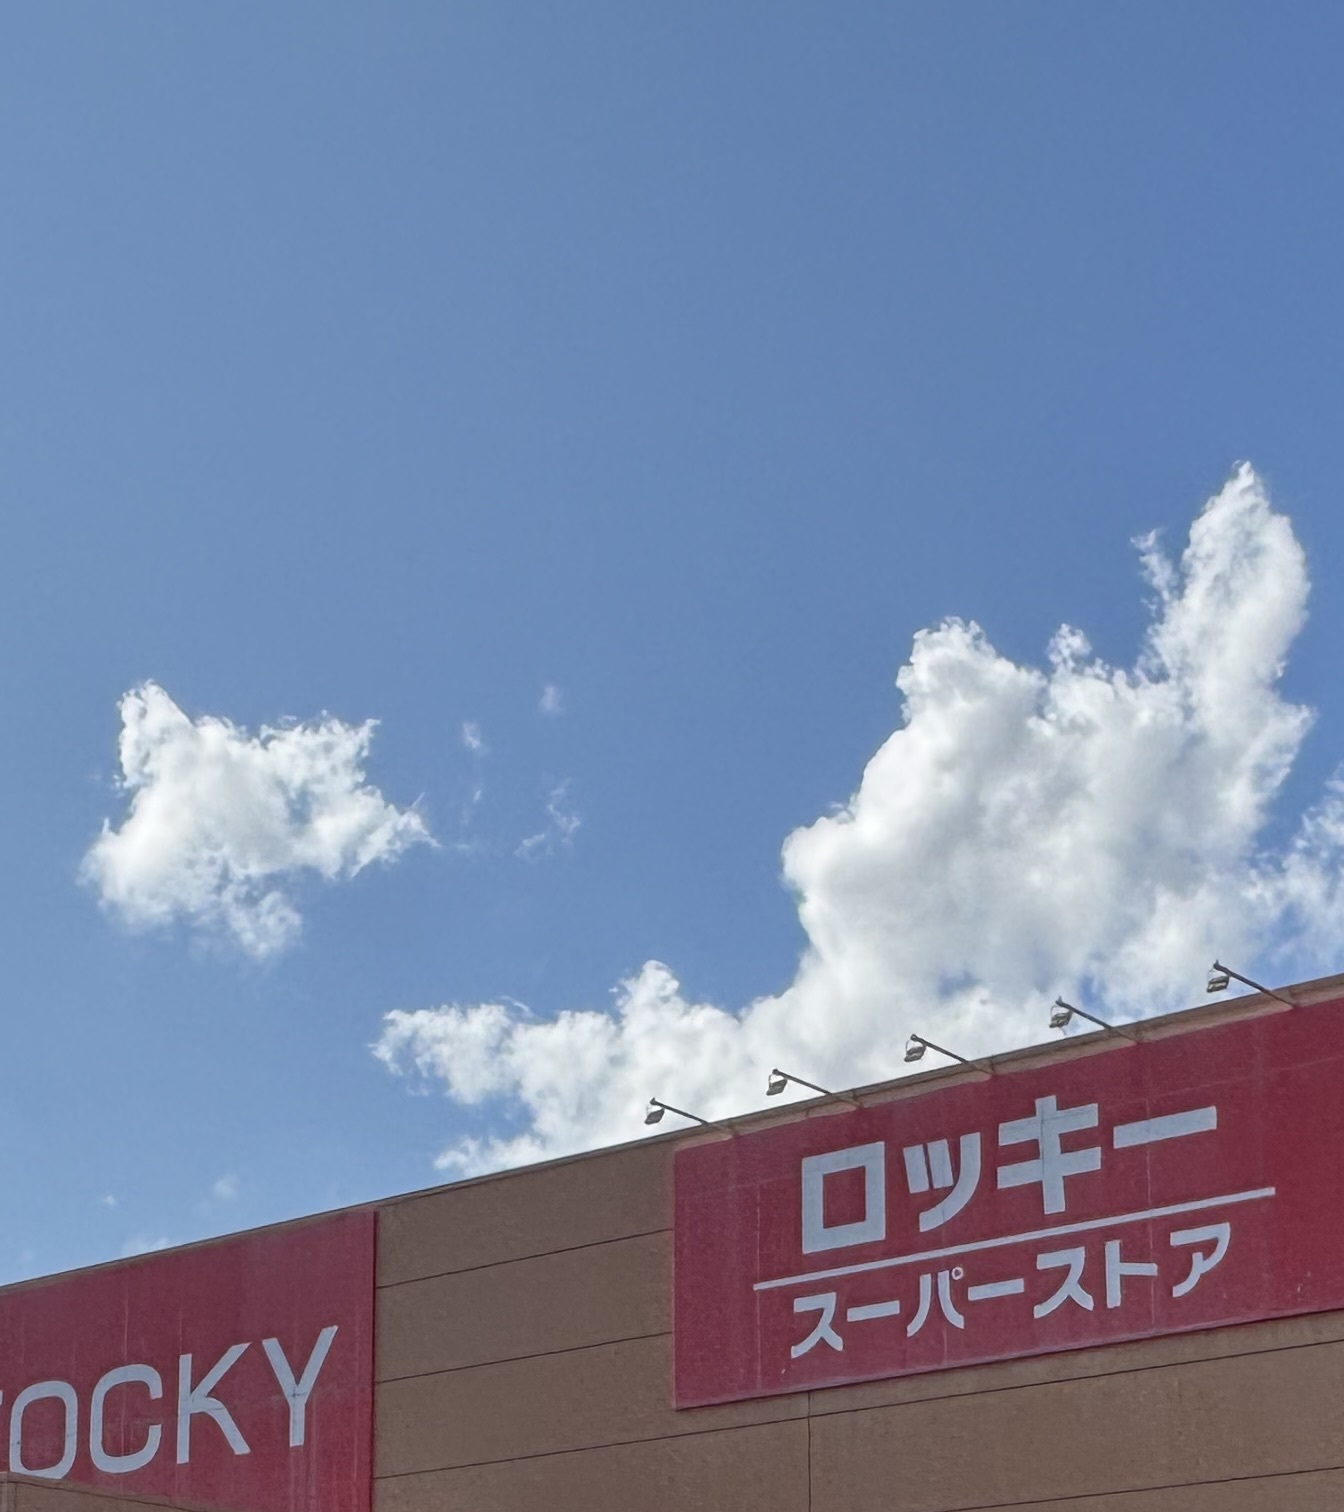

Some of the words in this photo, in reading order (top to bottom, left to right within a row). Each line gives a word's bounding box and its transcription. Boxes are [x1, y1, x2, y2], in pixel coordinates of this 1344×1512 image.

[801, 1095, 1218, 1254] ロッキー
[790, 1222, 1231, 1359] スーパーストア
